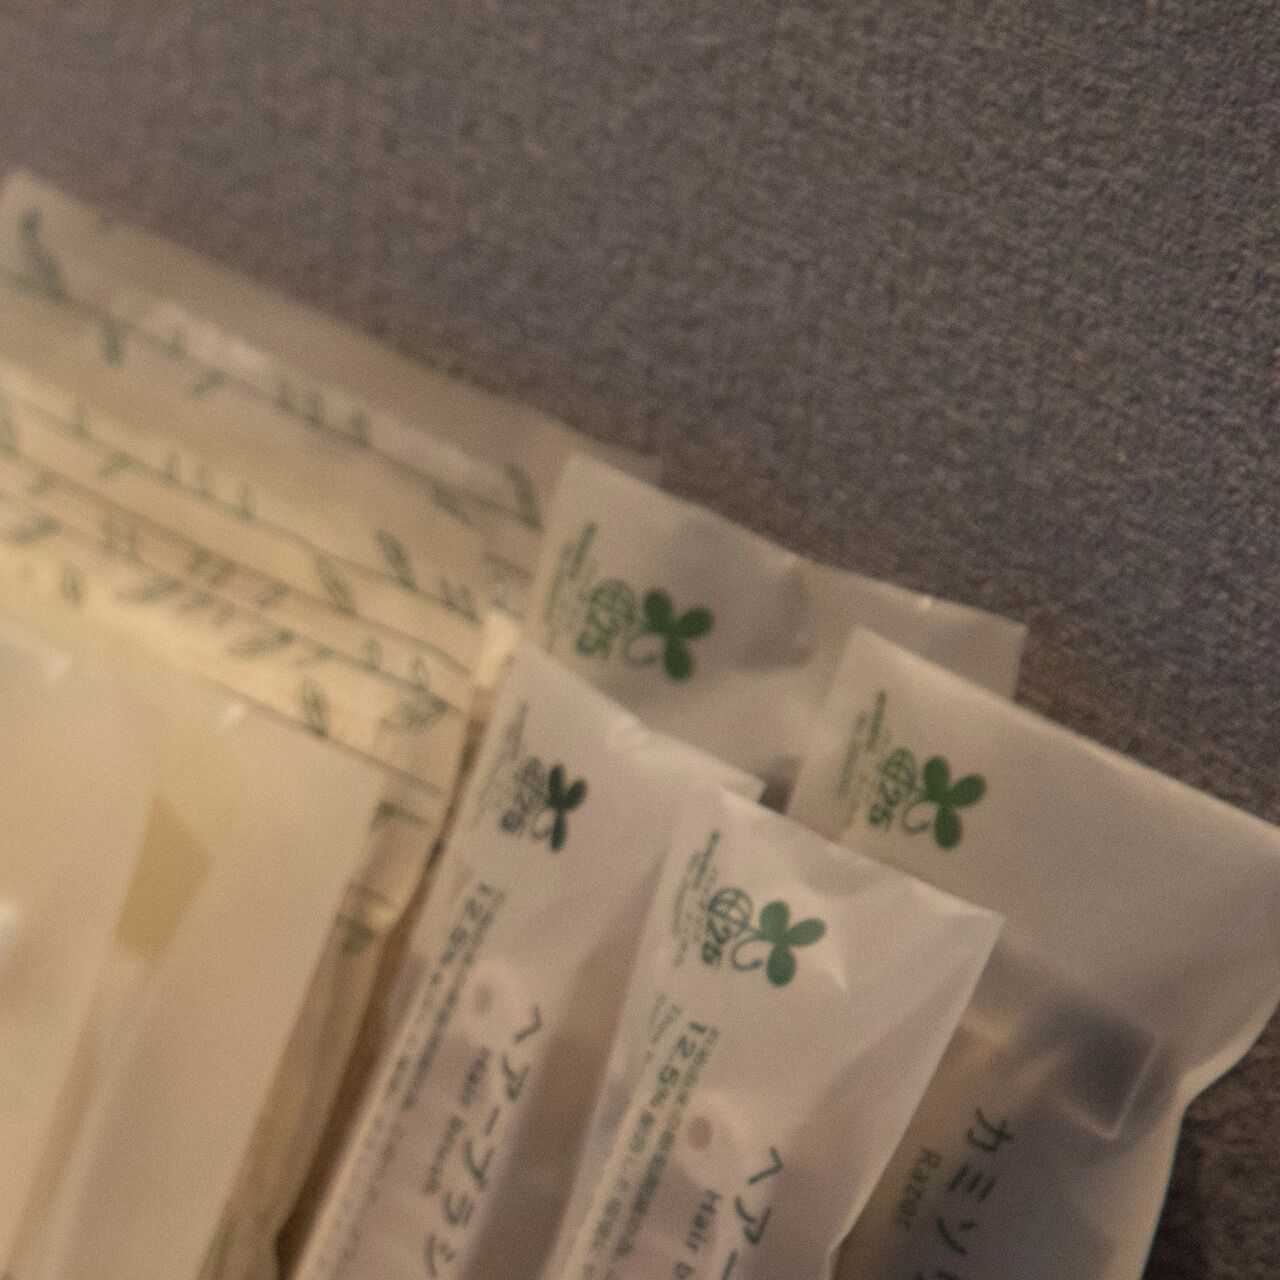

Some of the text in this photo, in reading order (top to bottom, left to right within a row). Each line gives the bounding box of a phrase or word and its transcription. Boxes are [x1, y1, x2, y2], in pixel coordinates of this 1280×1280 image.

[423, 1004, 542, 1280] ヘアーブラシ
[685, 1188, 722, 1251] Hair
[894, 1146, 941, 1229] Razor
